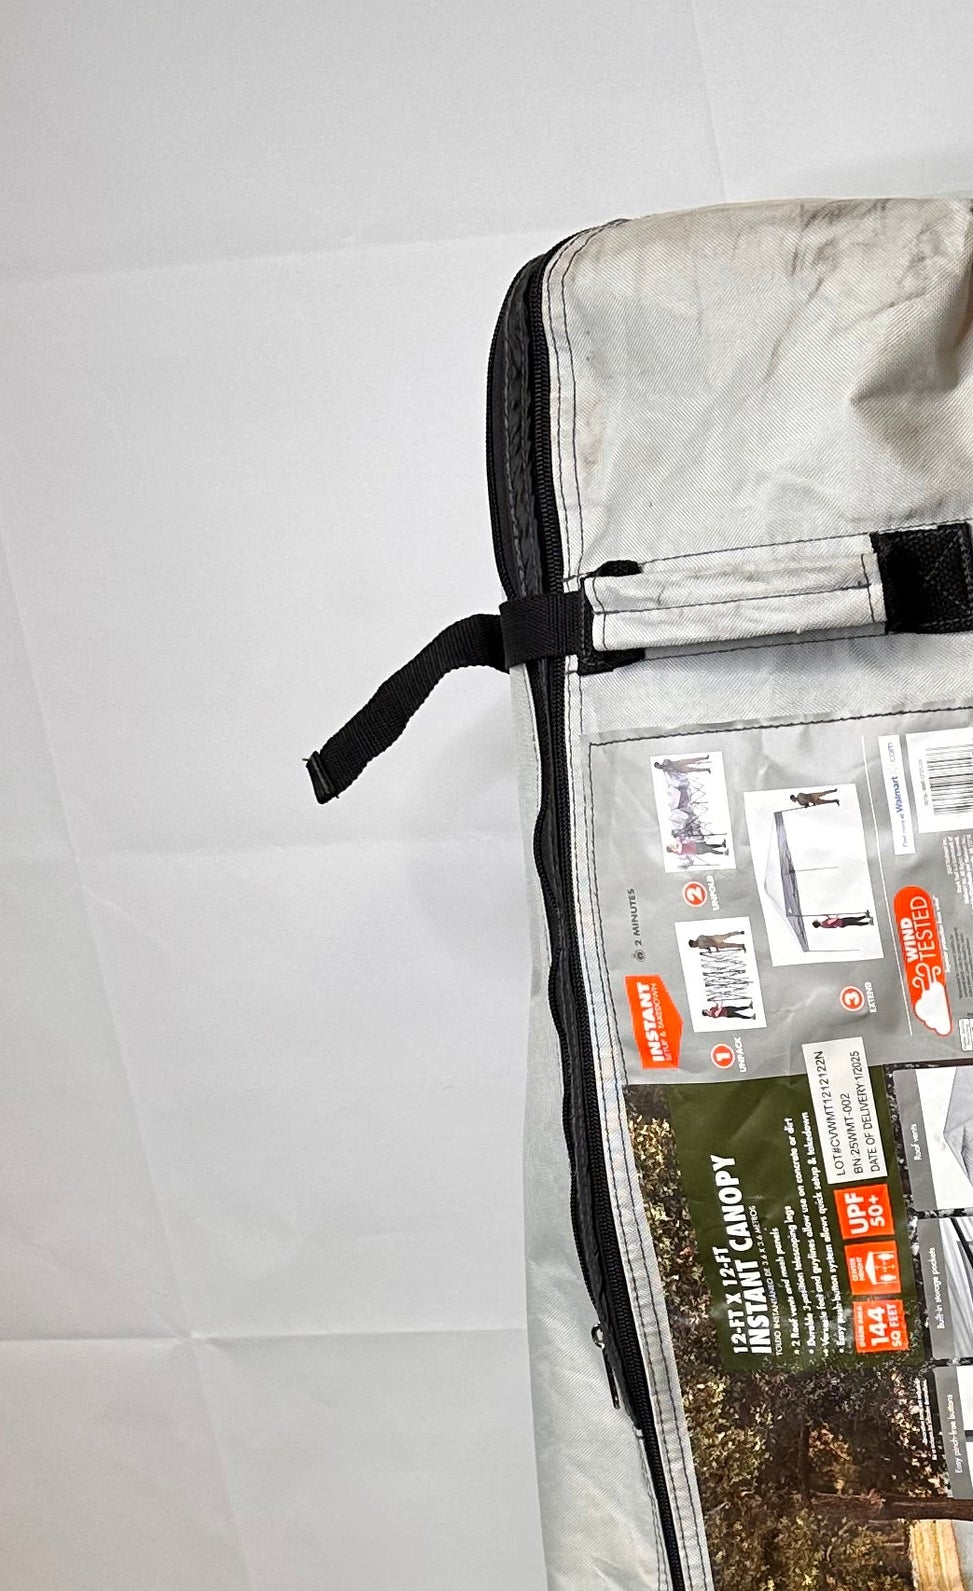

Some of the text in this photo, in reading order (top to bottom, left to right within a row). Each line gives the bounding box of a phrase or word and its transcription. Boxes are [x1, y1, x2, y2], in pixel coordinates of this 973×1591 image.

[890, 775, 904, 812] Walmart
[687, 886, 702, 901] 2
[706, 875, 719, 910] UNFOLD
[627, 888, 640, 936] MINUTES
[900, 917, 918, 962] WIND
[911, 896, 936, 960] TESTED
[650, 982, 664, 1028] TAKEDOWN
[844, 991, 856, 1003] 3
[864, 981, 876, 1012] EXTEND
[637, 982, 664, 1061] INSTANT
[715, 1052, 729, 1061] 1
[734, 1036, 746, 1072] UNPACK
[783, 1117, 794, 1133] dirt
[813, 1050, 845, 1176] LOT#CVWMT1212122N
[788, 1135, 796, 1145] or
[801, 1111, 815, 1155] takedown
[864, 1132, 875, 1145] OF
[910, 1123, 922, 1160] Roof vents
[789, 1147, 802, 1183] concrete
[867, 1147, 880, 1171] DATE
[797, 1185, 805, 1196] on
[811, 1166, 821, 1189] setup
[799, 1198, 808, 1212] use
[813, 1191, 827, 1214] quick
[844, 1192, 868, 1234] UPF
[868, 1194, 885, 1226] 50+
[749, 1205, 761, 1233] METROS
[801, 1214, 813, 1237] allow
[819, 1215, 830, 1242] allows
[711, 1154, 772, 1353] INSTANT CANOPY
[755, 1234, 764, 1246] 3.6
[770, 1227, 785, 1254] panels
[760, 1254, 768, 1265] 3.6
[776, 1256, 787, 1277] mesh
[807, 1238, 822, 1273] guylines
[825, 1244, 837, 1272] system
[763, 1267, 771, 1276] DE
[784, 1205, 816, 1346] Durable 3-position telescoping legs
[810, 1275, 822, 1292] and
[712, 1246, 748, 1353] 12-FT X 12-FT
[780, 1278, 792, 1294] and
[830, 1274, 846, 1323] push-button
[928, 1247, 945, 1328] Built-in storage pockets
[787, 1295, 797, 1316] vents
[815, 1293, 826, 1309] feet
[787, 1318, 799, 1338] Roof
[836, 1325, 848, 1345] Easy
[867, 1306, 888, 1345] 144
[886, 1303, 902, 1346] SQ FEET
[773, 1330, 782, 1355] TOLDO
[946, 1394, 963, 1473] Easy pinch-free buttons
